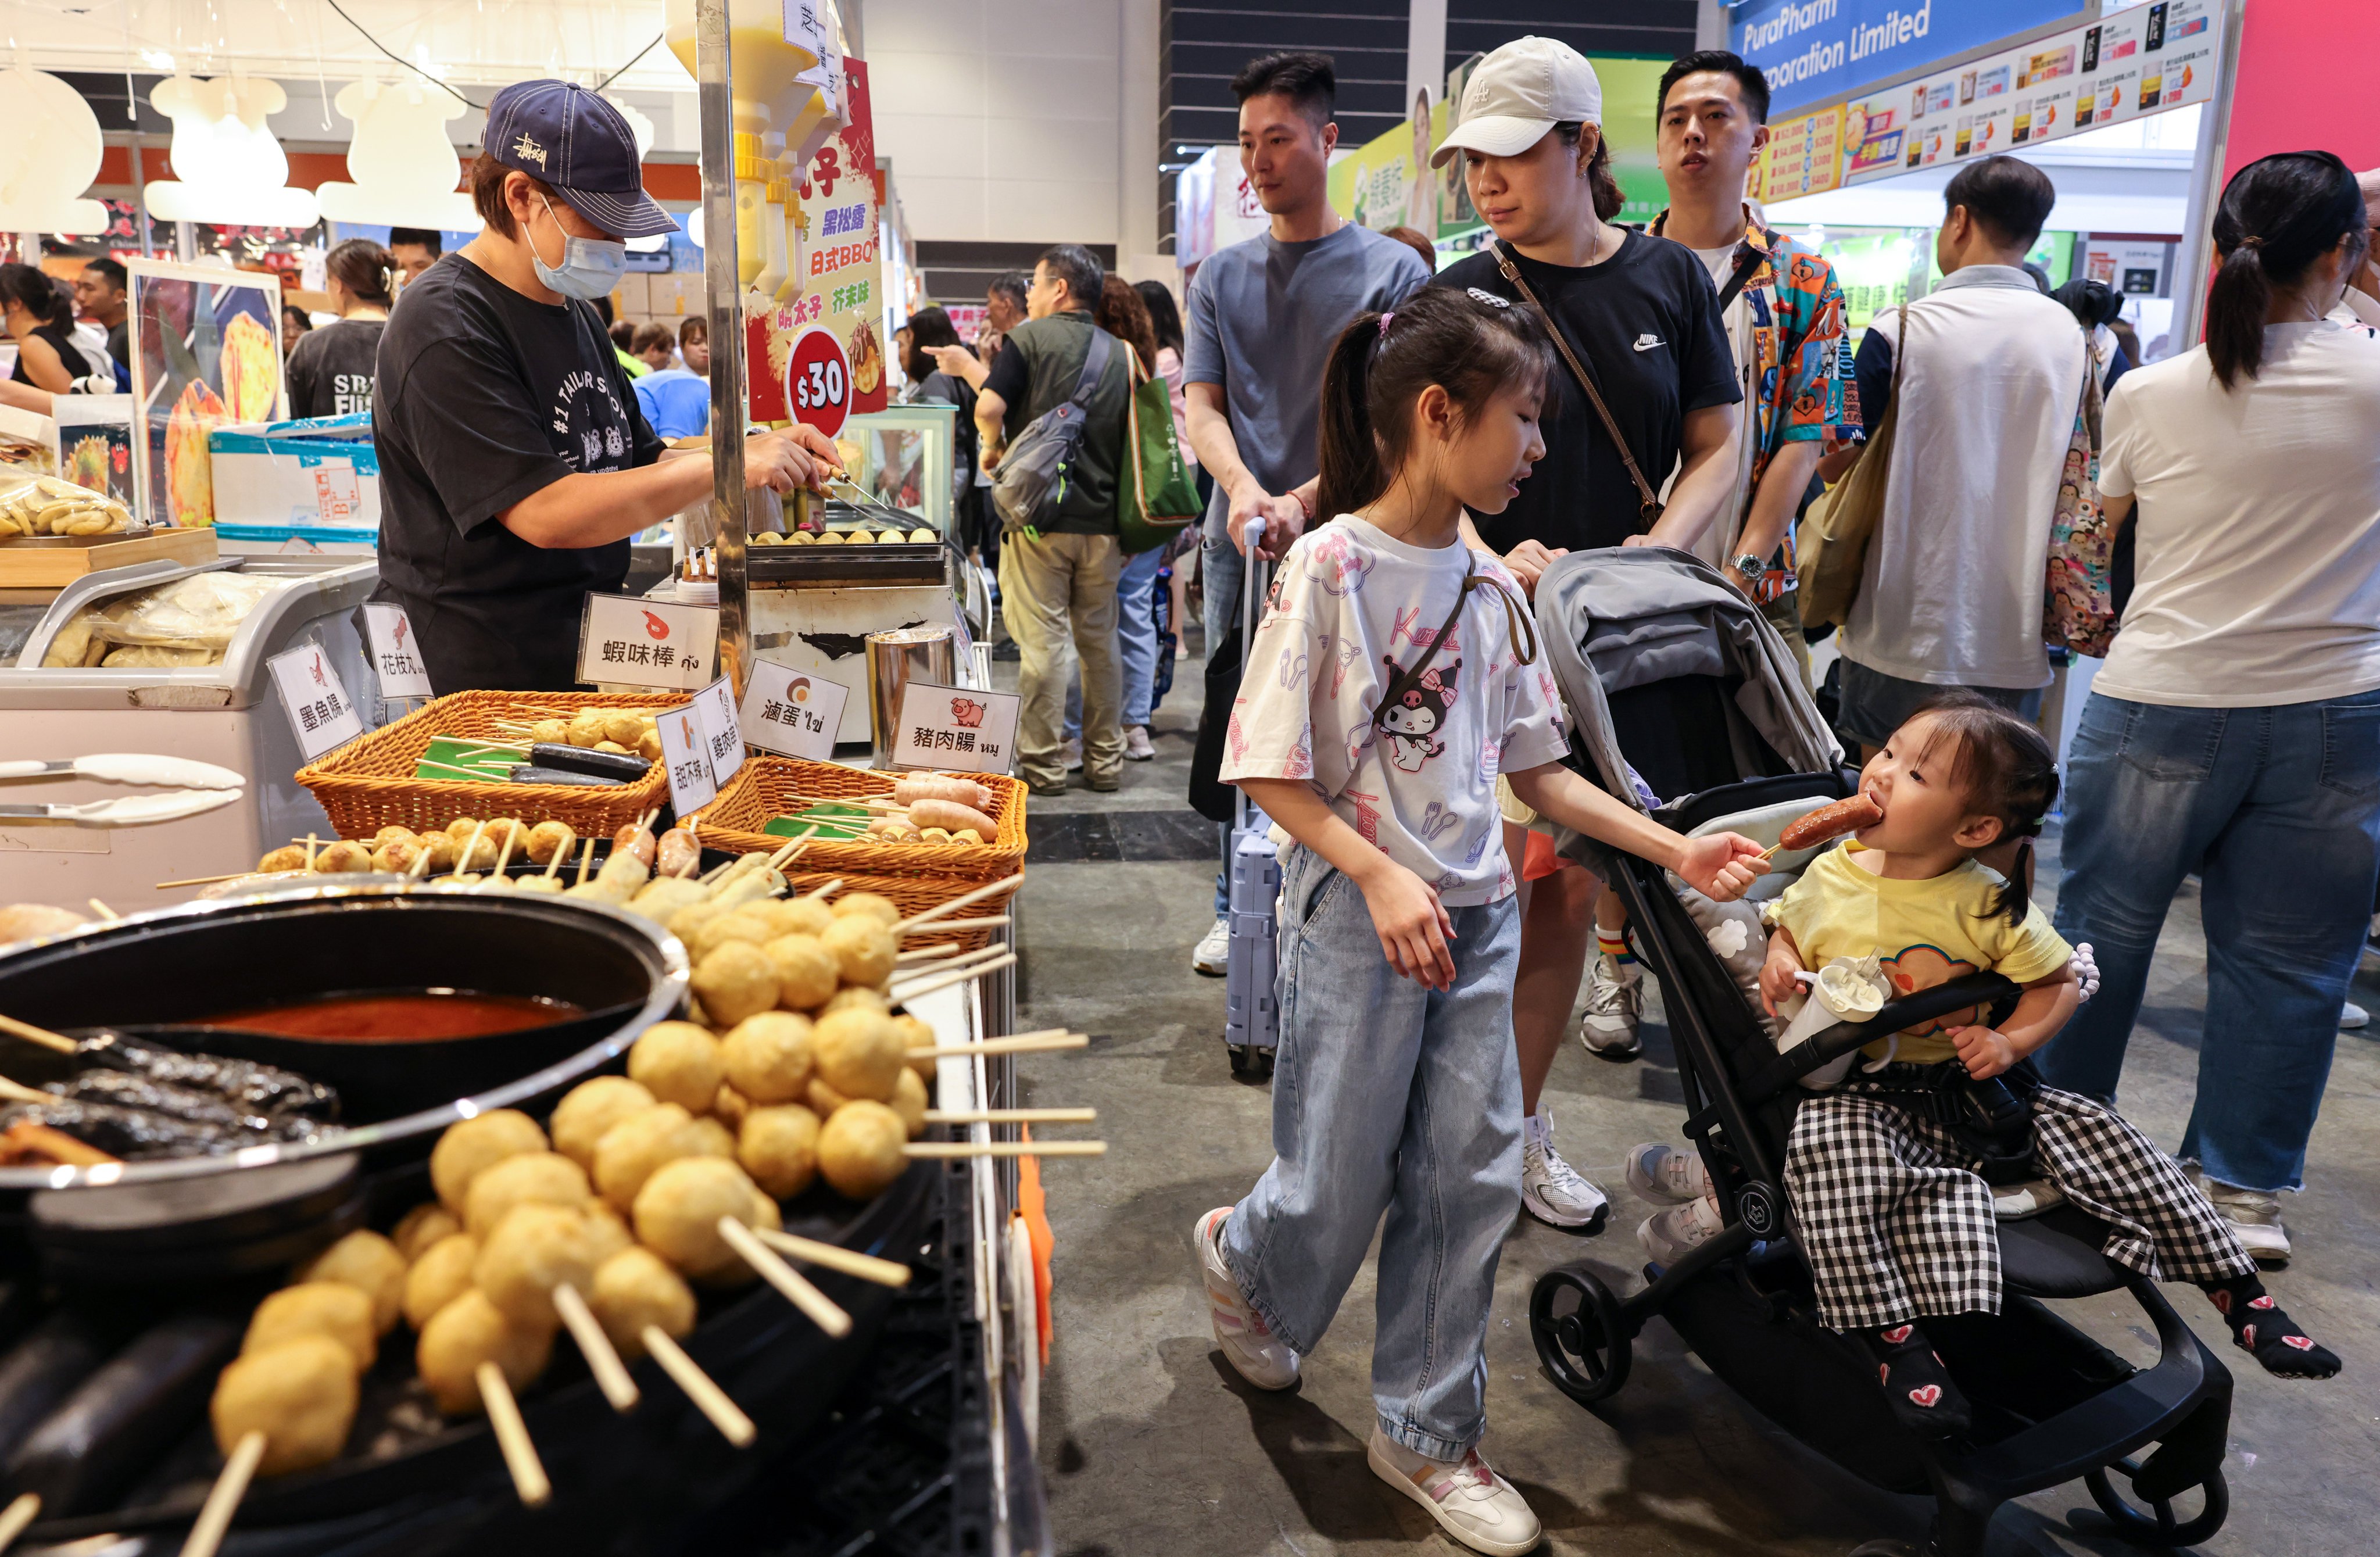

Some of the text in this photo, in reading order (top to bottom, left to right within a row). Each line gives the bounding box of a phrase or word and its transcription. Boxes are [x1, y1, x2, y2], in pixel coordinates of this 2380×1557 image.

[1743, 0, 1837, 55] PuraPharm
[1762, 0, 1931, 91] rporation Limited
[822, 203, 866, 237] 黑松露
[811, 240, 873, 277] 日式BBQ
[832, 280, 869, 314] 芥末味
[1638, 334, 1658, 345] NIKE
[797, 359, 844, 409] $30
[553, 371, 627, 434] #1 TAILR SOP
[381, 653, 417, 675] 花枝丸
[602, 640, 675, 667] 蝦味棒
[299, 693, 343, 732] 墨魚腸
[761, 699, 825, 733] 滷蛋 ไข่
[711, 725, 738, 761] 雞肉串
[914, 727, 999, 757] 豬肉腸 หมู
[674, 760, 703, 791] 甜不辣
